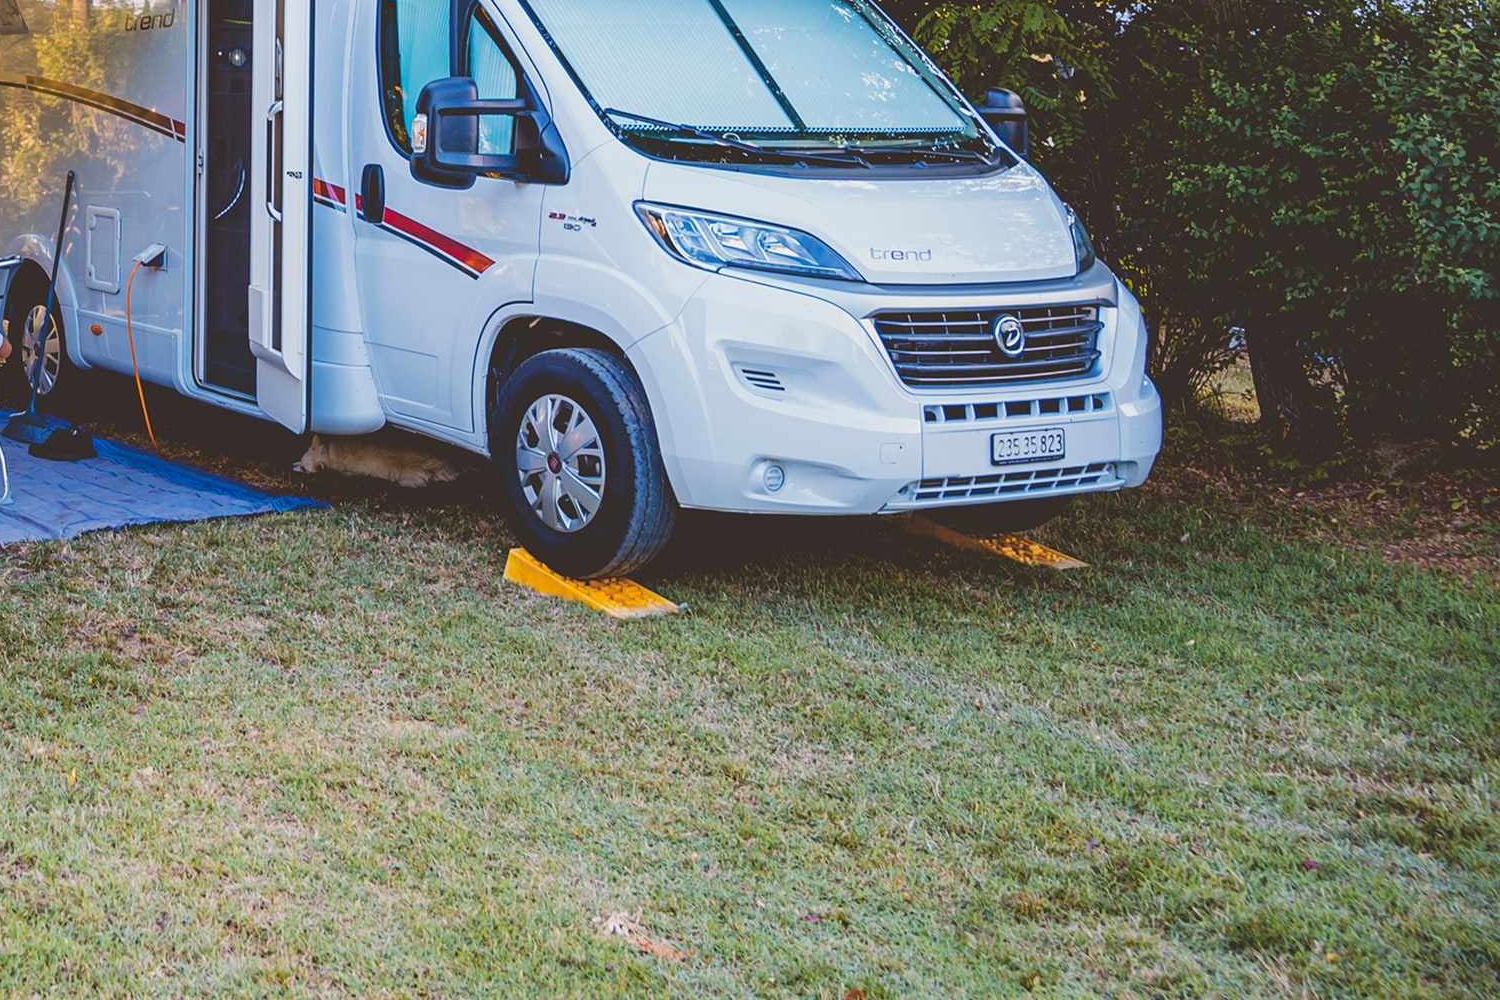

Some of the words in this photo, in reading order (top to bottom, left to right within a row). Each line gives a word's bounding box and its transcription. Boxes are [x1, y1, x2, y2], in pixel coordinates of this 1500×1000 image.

[125, 8, 176, 31] trend
[869, 247, 932, 261] trend
[998, 438, 1020, 457] 235
[1023, 435, 1037, 455] 35
[1040, 433, 1062, 453] 823
